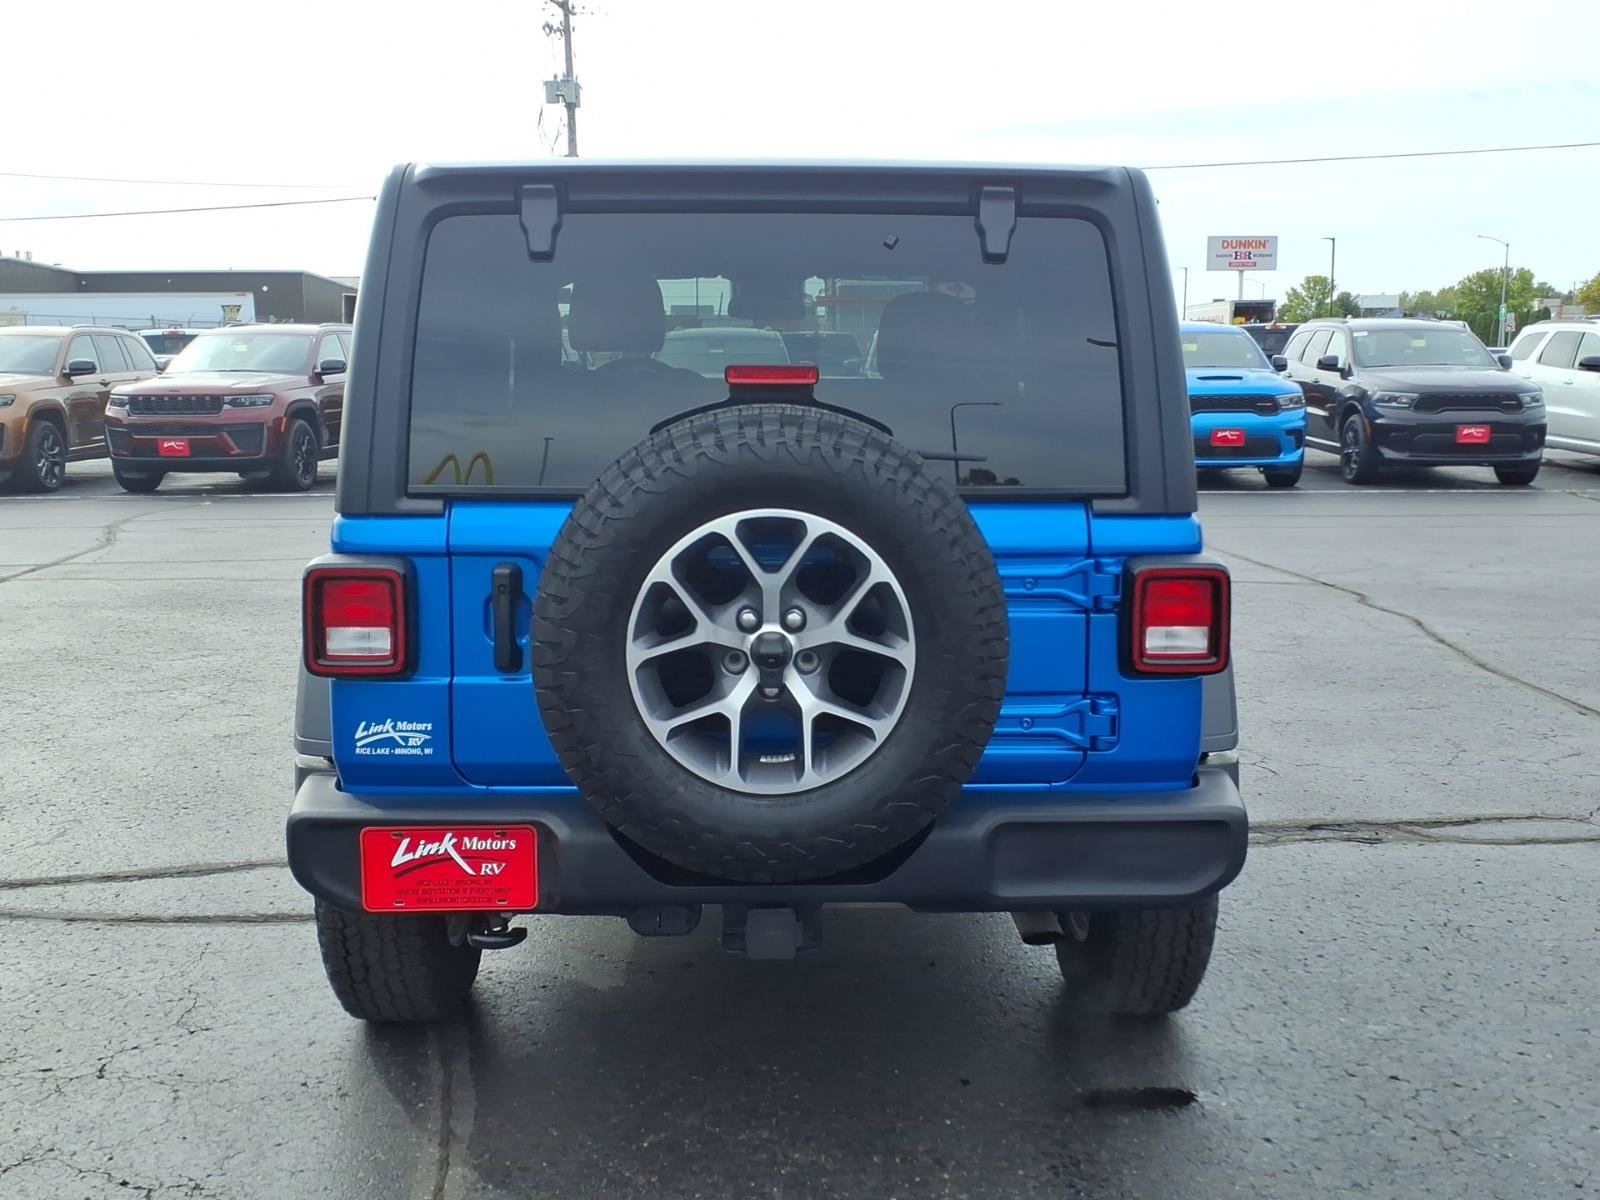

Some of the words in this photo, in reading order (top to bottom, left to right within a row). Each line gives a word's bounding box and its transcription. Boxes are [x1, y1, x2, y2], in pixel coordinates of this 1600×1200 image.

[1221, 239, 1269, 249] DUNKIN'
[1234, 251, 1252, 260] BR
[354, 718, 406, 746] Link
[395, 721, 432, 731] Motors
[407, 738, 425, 746] RV
[355, 747, 371, 755] RICE
[372, 747, 390, 755] LAKE
[394, 747, 423, 756] MINONG,
[424, 747, 433, 755] WI
[391, 832, 476, 876] Link
[461, 836, 516, 850] Motors
[480, 862, 507, 876] RV
